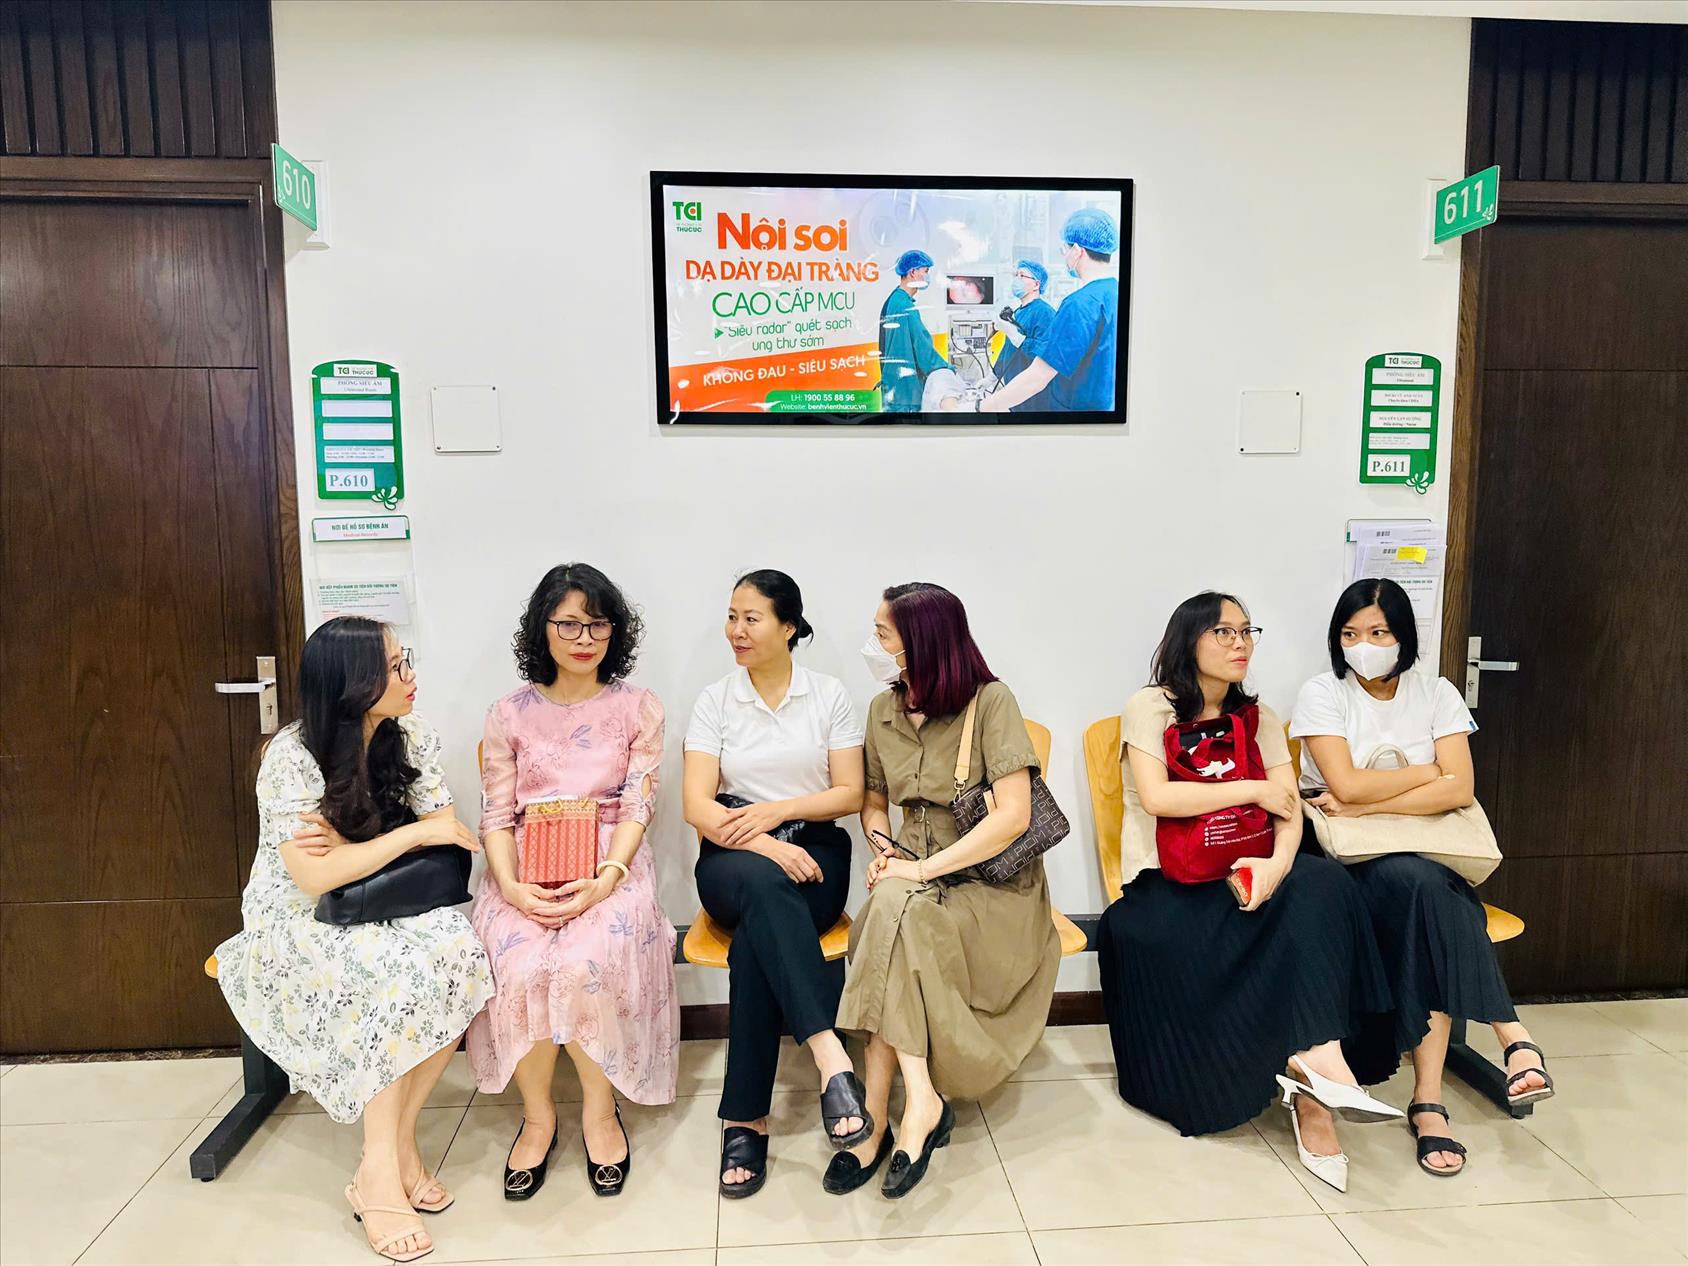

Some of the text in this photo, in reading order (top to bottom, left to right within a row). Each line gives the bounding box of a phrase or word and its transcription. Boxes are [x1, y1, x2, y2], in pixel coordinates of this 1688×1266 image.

[283, 160, 311, 210] 610
[672, 201, 702, 221] TCI
[1444, 180, 1483, 224] 611
[717, 212, 848, 252] Nội soi
[686, 256, 879, 283] DẠ DÀY ĐẠI TRÀNG
[712, 286, 855, 318] CAO CẤP MCU
[795, 318, 822, 334] quét
[826, 316, 852, 332] sạch
[752, 340, 772, 352] ung
[776, 336, 797, 350] thư
[338, 366, 350, 374] TCI
[758, 364, 786, 380] ĐAU
[798, 358, 826, 375] SIÊU
[830, 354, 865, 372] SẠCH
[1372, 460, 1404, 472] P.611
[330, 474, 368, 487] P.610
